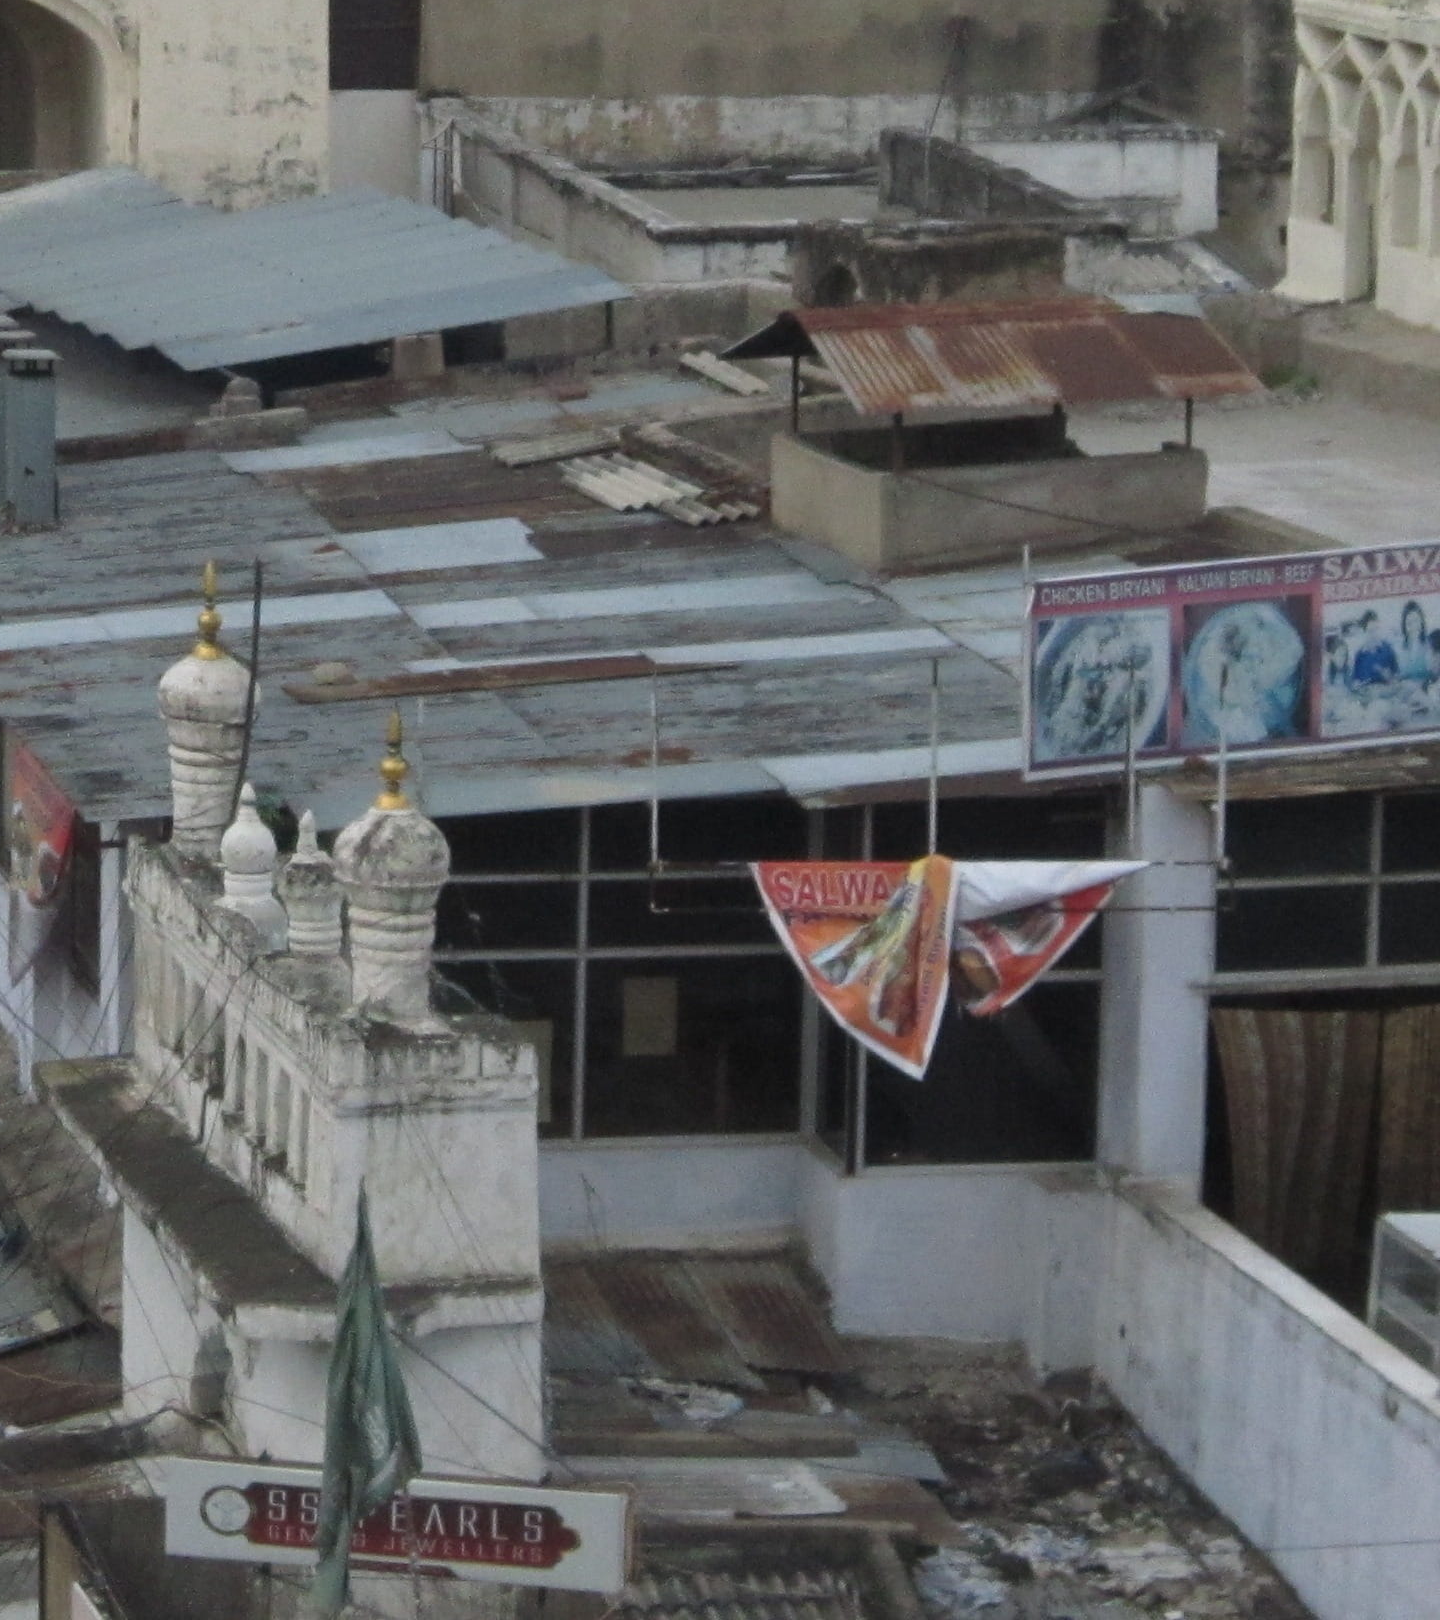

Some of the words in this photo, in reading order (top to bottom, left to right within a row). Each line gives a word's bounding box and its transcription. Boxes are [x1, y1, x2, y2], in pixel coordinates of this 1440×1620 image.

[1229, 567, 1276, 588] BIRYANI
[1284, 563, 1316, 584] BEEF
[1040, 585, 1105, 606] CHICKEN
[1109, 578, 1165, 600] BIRYANI
[773, 871, 892, 908] SALWA
[269, 1489, 319, 1525] SS
[358, 1499, 544, 1543] EARLS
